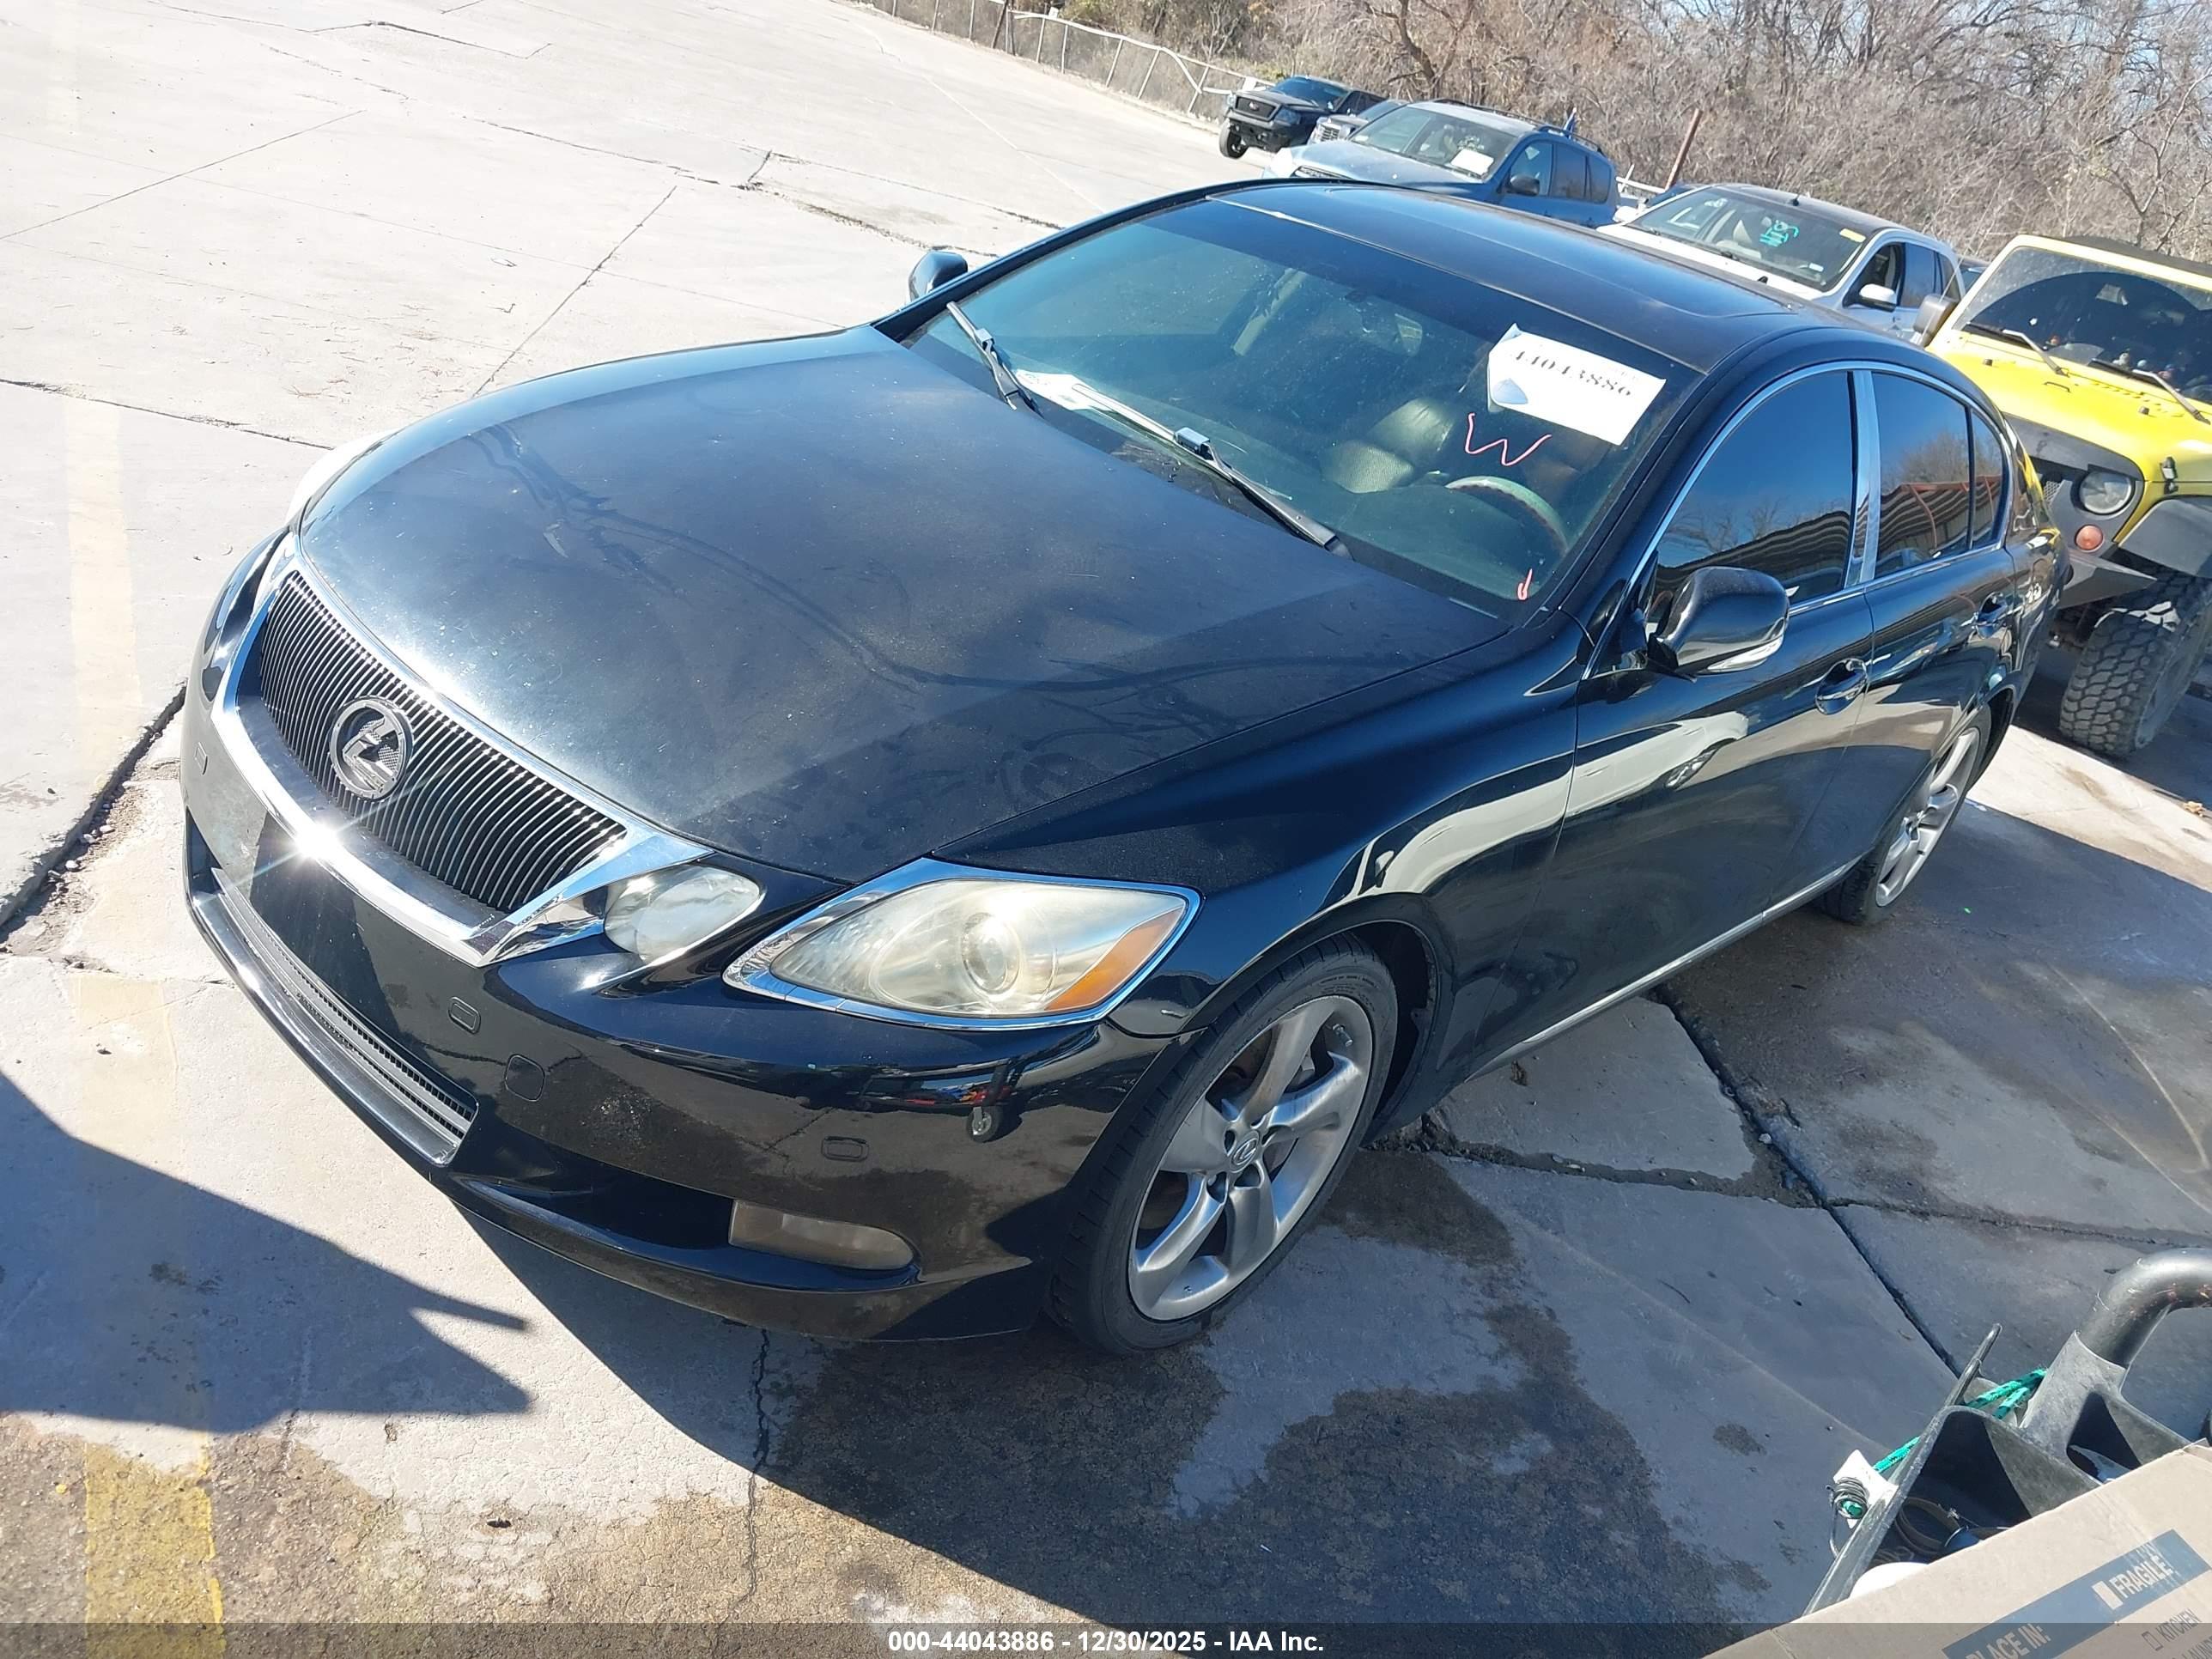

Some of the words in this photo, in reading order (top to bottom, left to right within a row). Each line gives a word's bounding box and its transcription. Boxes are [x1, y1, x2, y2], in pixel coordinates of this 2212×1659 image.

[2108, 1555, 2174, 1599] FRAGILE
[2018, 1623, 2051, 1649] IN:
[2155, 1607, 2201, 1643] KITCHEN
